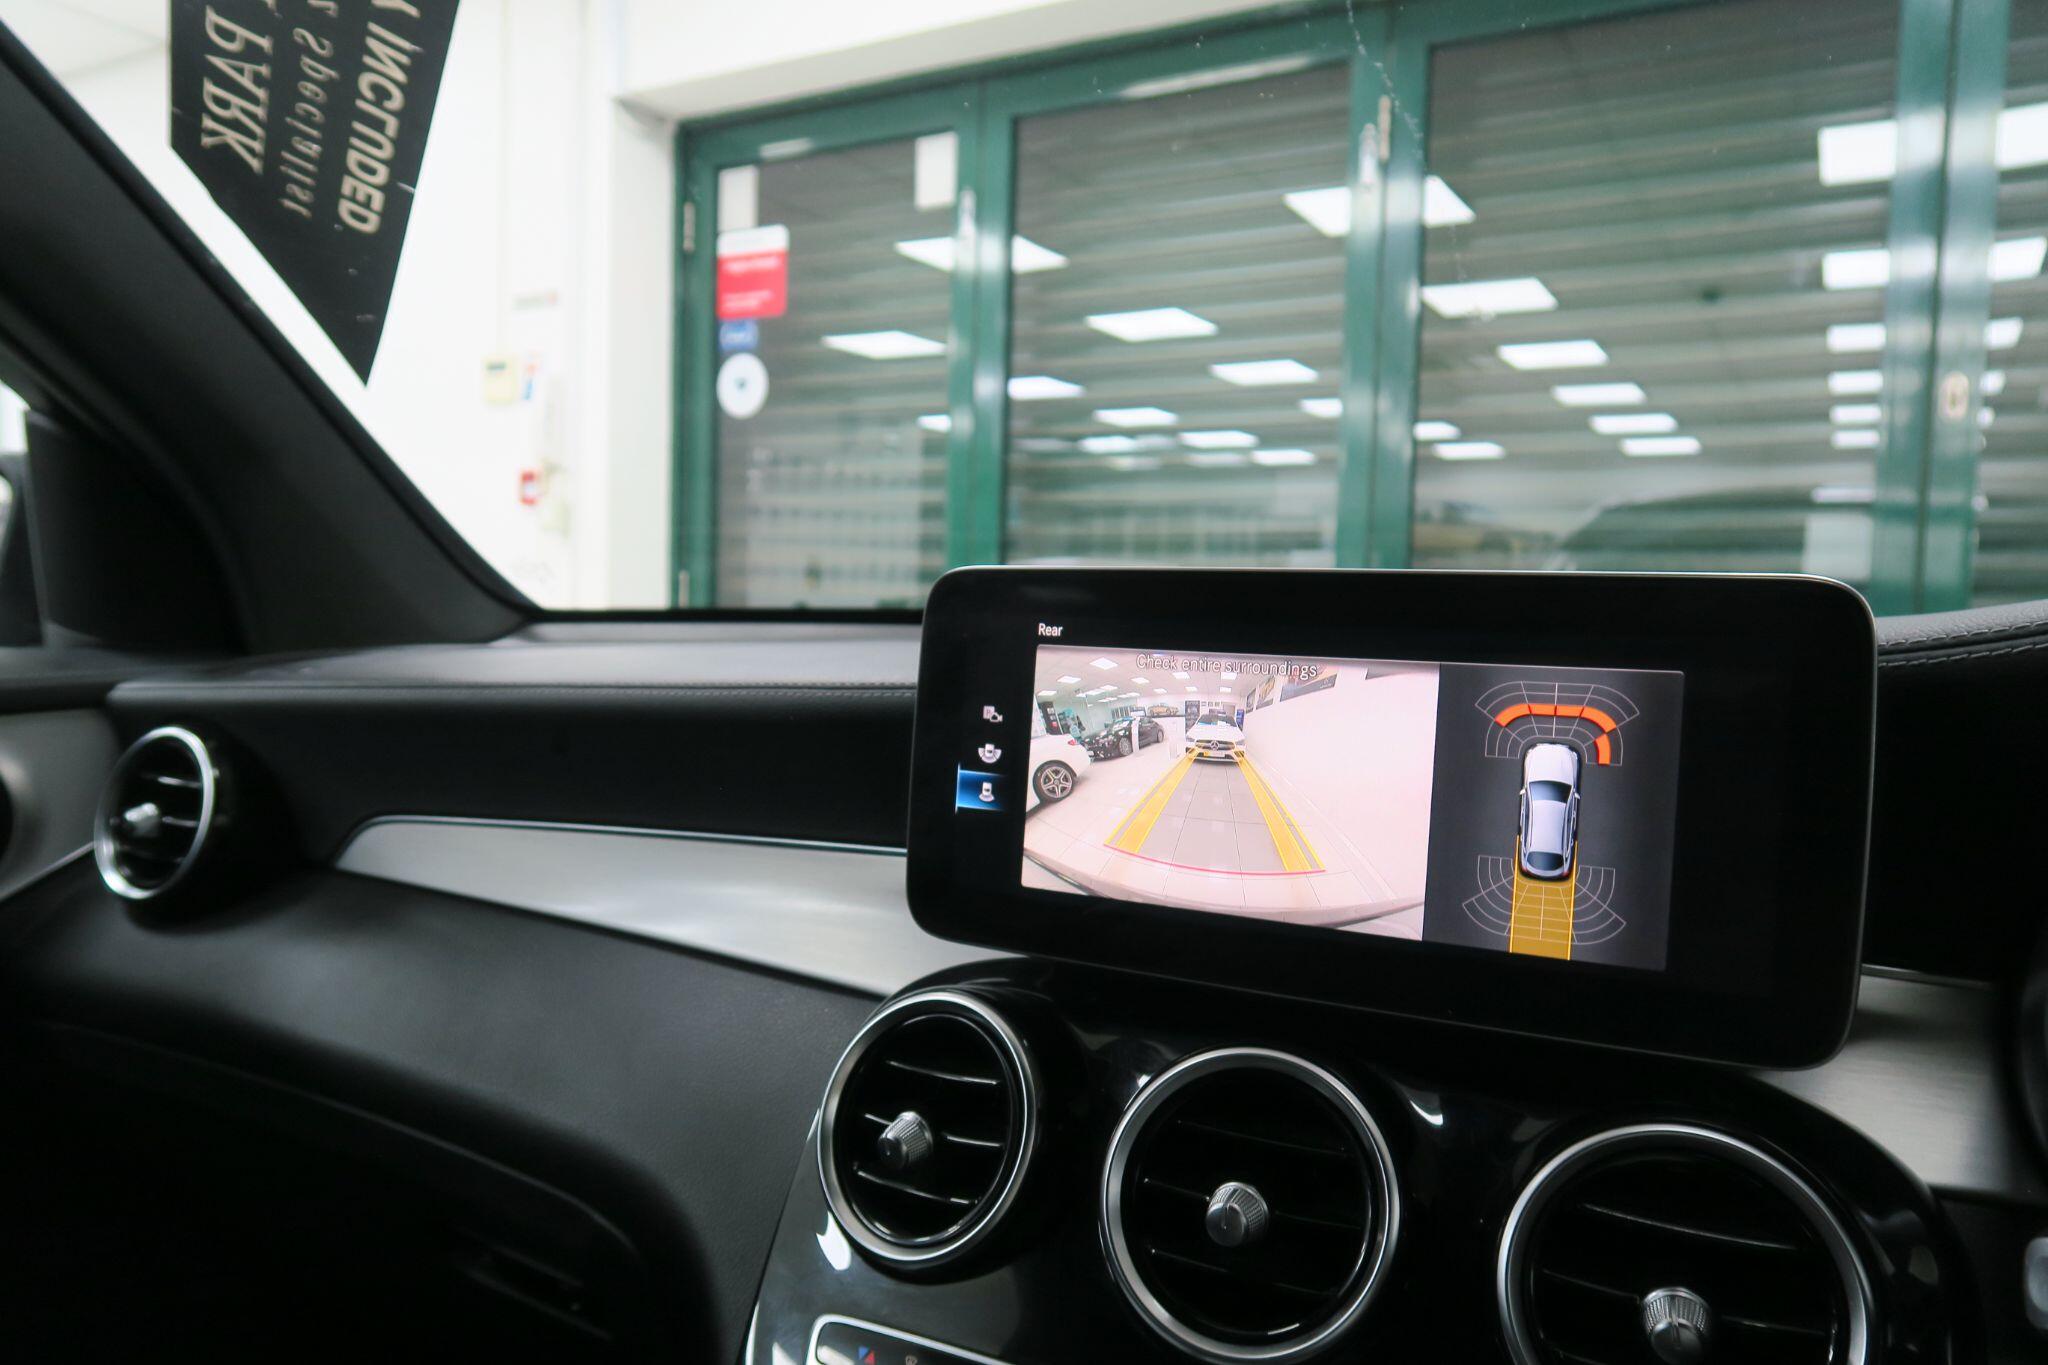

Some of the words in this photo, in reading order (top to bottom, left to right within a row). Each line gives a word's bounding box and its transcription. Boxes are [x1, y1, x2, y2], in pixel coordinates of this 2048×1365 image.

[1038, 622, 1063, 637] Rear
[1136, 653, 1176, 671] Check
[1182, 657, 1222, 674] entire
[1225, 661, 1317, 680] surroundings
